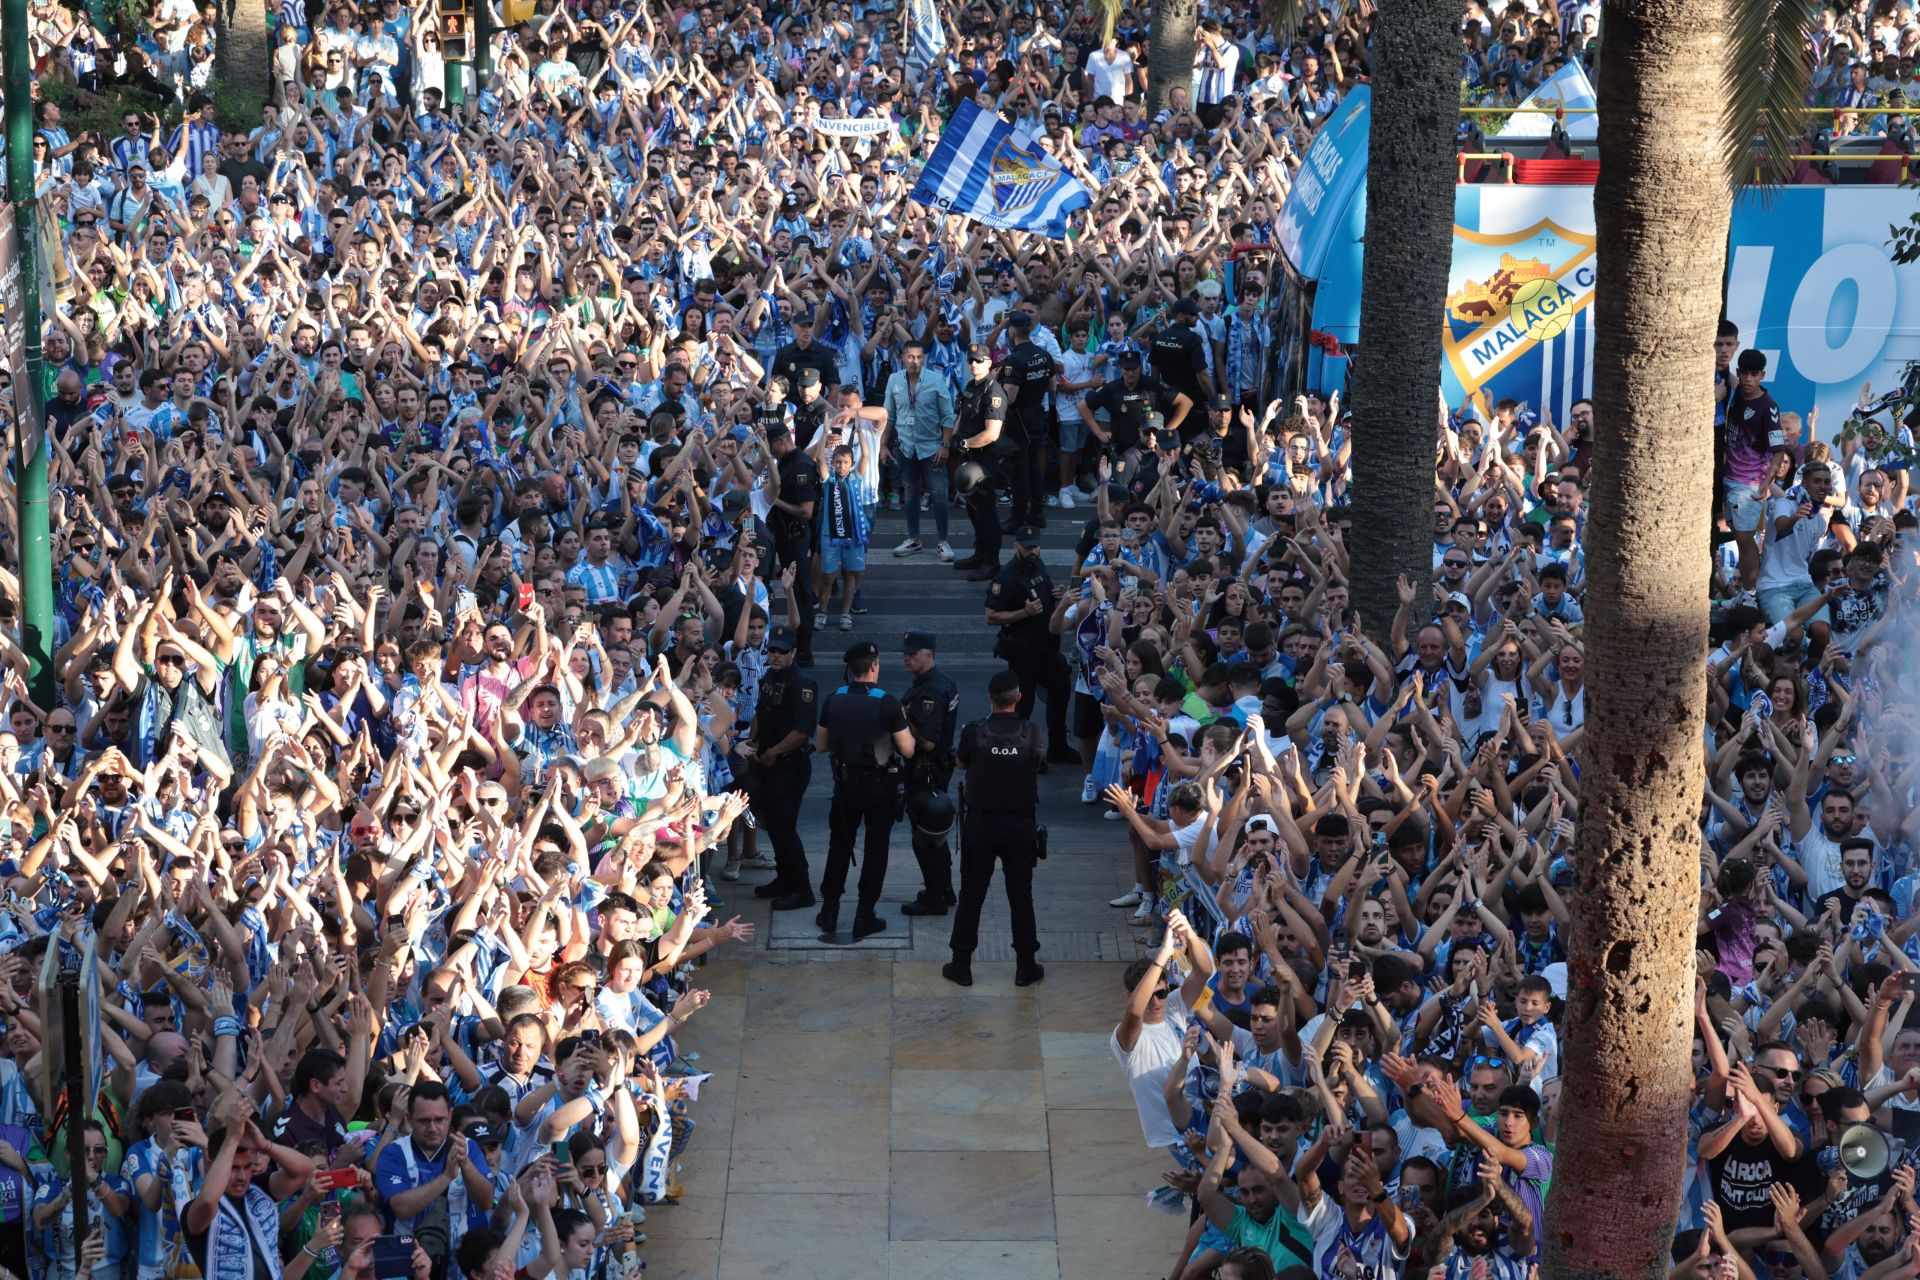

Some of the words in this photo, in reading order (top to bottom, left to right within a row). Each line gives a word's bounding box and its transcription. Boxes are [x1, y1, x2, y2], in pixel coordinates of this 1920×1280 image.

[1310, 130, 1343, 186] GRACIAS
[1538, 238, 1556, 247] TM
[1471, 284, 1576, 366] MALAGA
[991, 746, 1018, 756] G.O.A
[1736, 1159, 1773, 1182] ROCA
